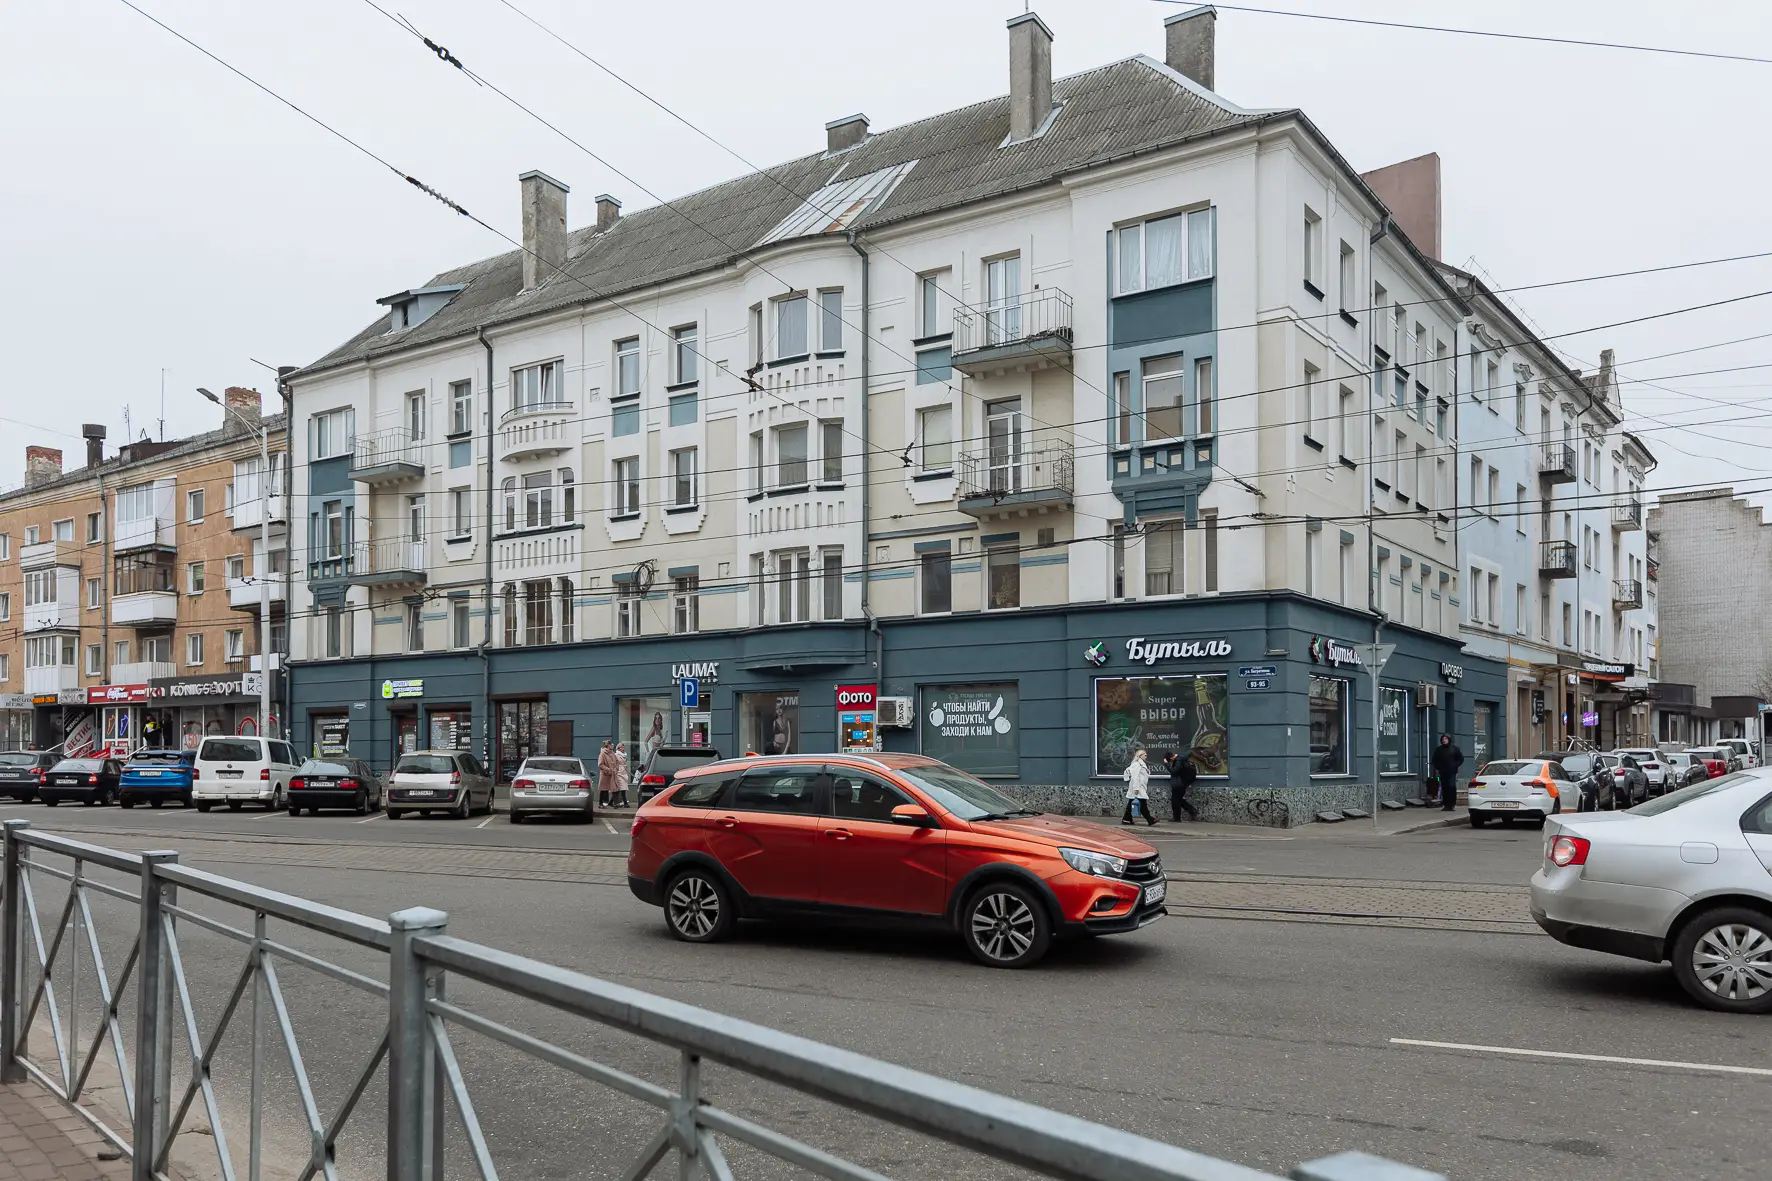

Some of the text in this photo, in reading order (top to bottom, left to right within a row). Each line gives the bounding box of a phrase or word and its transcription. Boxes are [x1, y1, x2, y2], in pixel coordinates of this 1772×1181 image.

[1126, 638, 1232, 665] Бутыль
[1327, 639, 1362, 667] Бутыл
[1441, 662, 1463, 679] ПАРОВОЗ
[685, 681, 695, 704] P
[838, 691, 872, 705] ФОТО
[943, 700, 991, 713] ЧТОБЫ НАЙТИ
[1148, 694, 1177, 706] Super
[946, 714, 987, 725] ПРОДУКТЫ,
[1140, 707, 1186, 720] ВЫБОР
[941, 726, 992, 737] ЗАХОДИ К НАМ
[1145, 741, 1180, 749] любите!
[1148, 764, 1168, 773] ВХО
